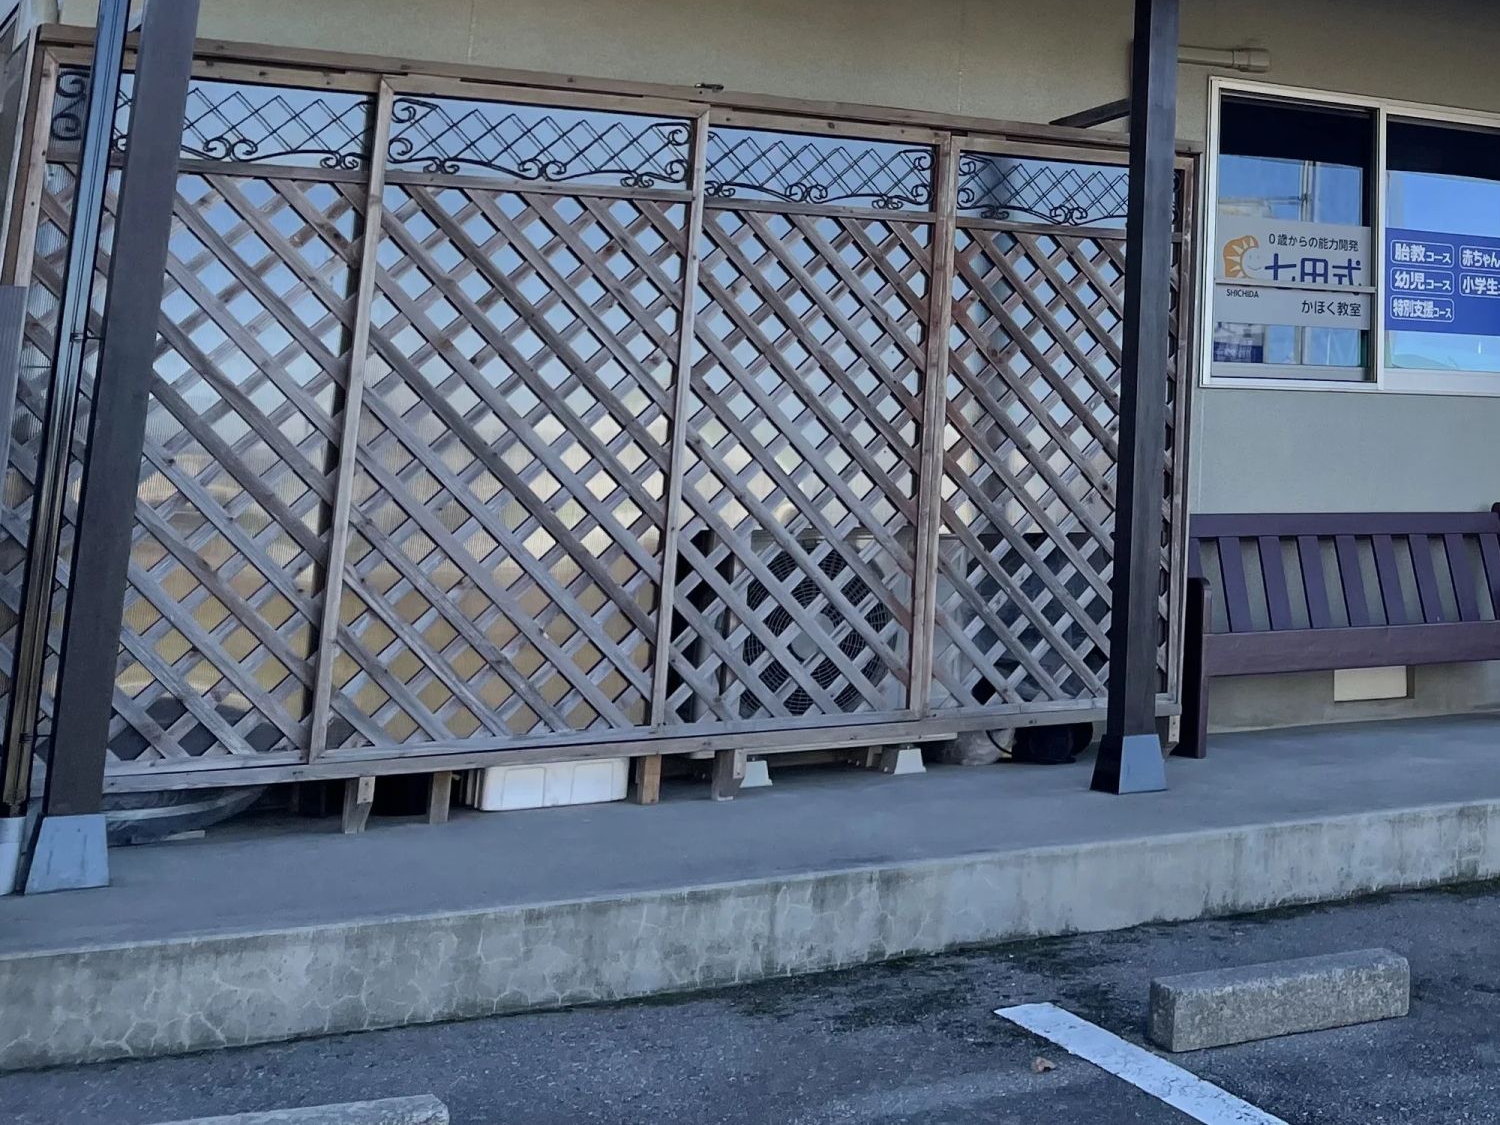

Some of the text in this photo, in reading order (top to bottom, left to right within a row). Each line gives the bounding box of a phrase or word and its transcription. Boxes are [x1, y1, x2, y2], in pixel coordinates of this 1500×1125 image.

[1394, 243, 1451, 263] 胎教コース
[1265, 253, 1361, 295] 七田式
[1394, 271, 1451, 291] 幼児コース
[1226, 288, 1259, 298] SHICHIDA
[1301, 299, 1361, 317] かほく教室
[1393, 299, 1452, 318] 特別支援コース
